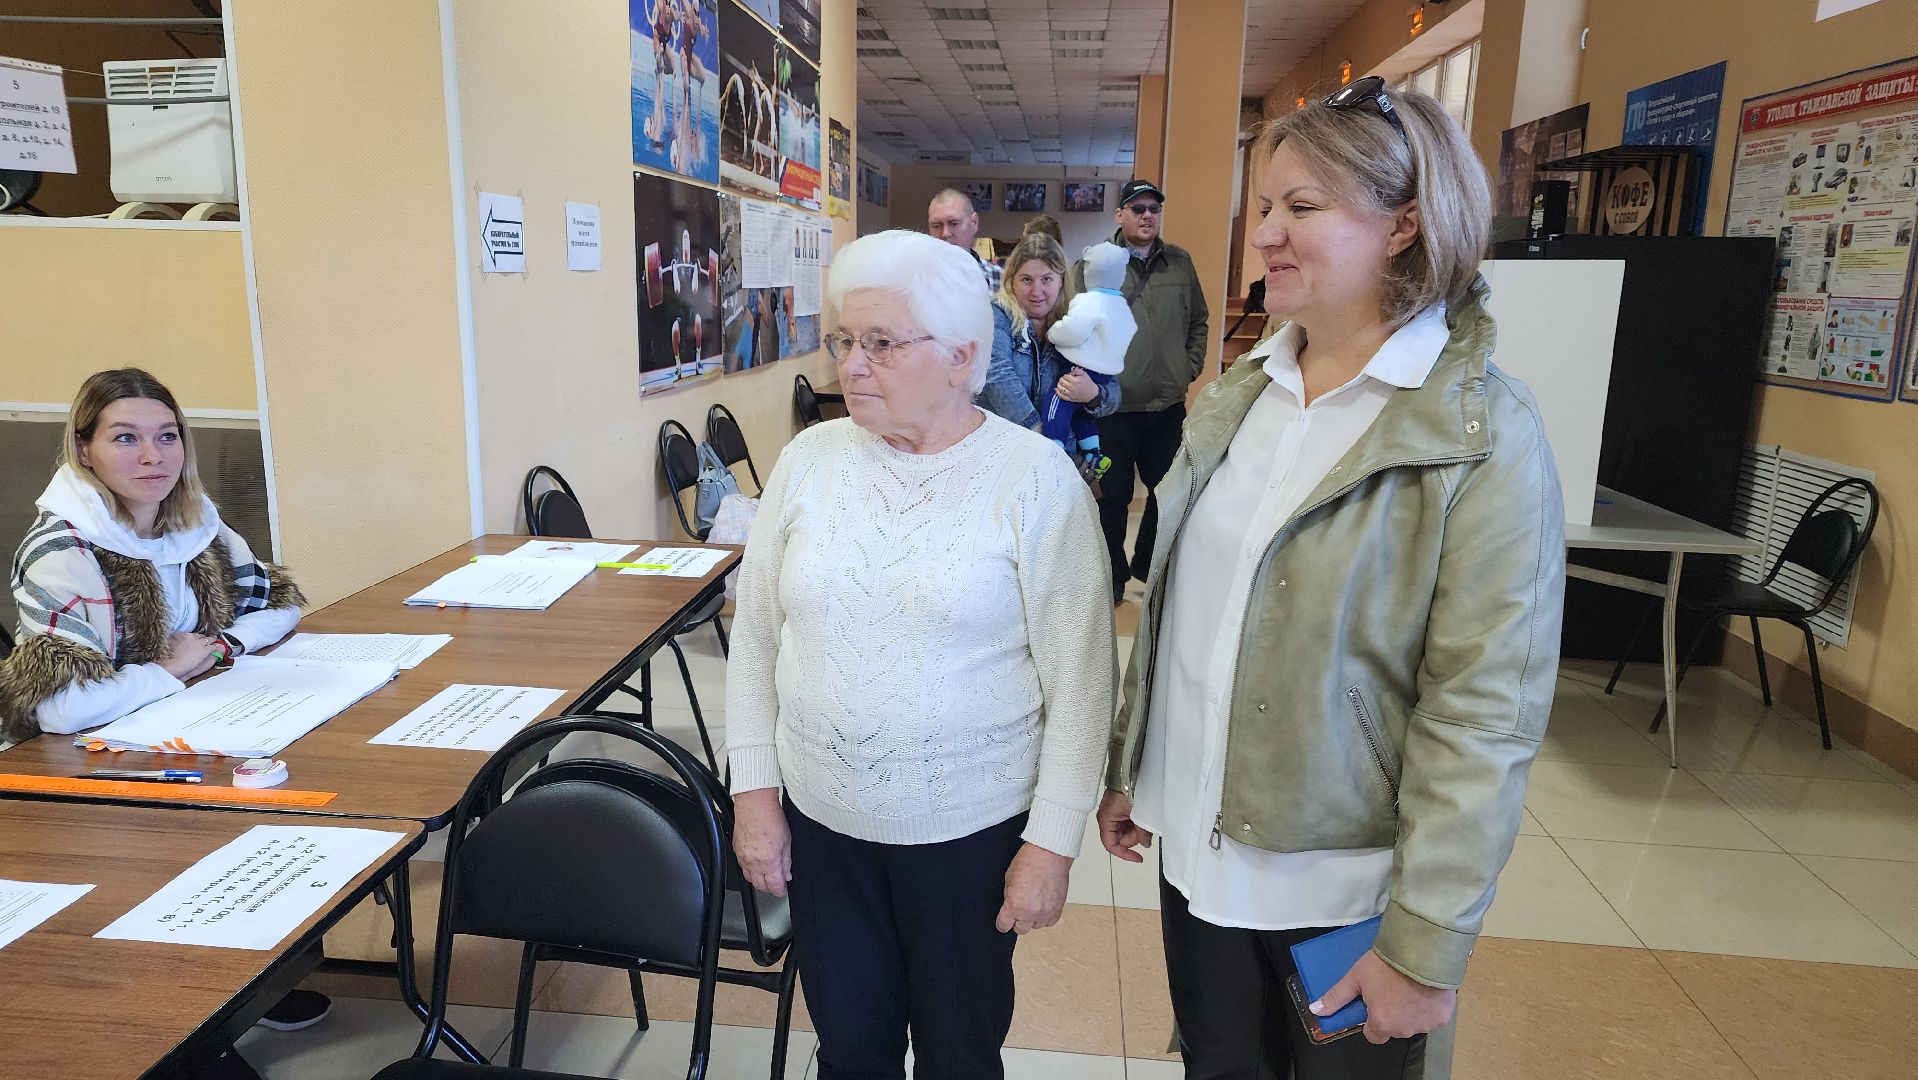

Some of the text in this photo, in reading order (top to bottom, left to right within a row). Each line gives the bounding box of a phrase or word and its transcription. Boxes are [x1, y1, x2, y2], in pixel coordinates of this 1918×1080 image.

[13, 80, 20, 90] 5
[1766, 75, 1914, 123] УГОЛОК ГРАЖДАНСКОЙ ЗАЩИТЫ
[1626, 100, 1647, 132] ГТО
[1611, 181, 1650, 210] КОФЕ
